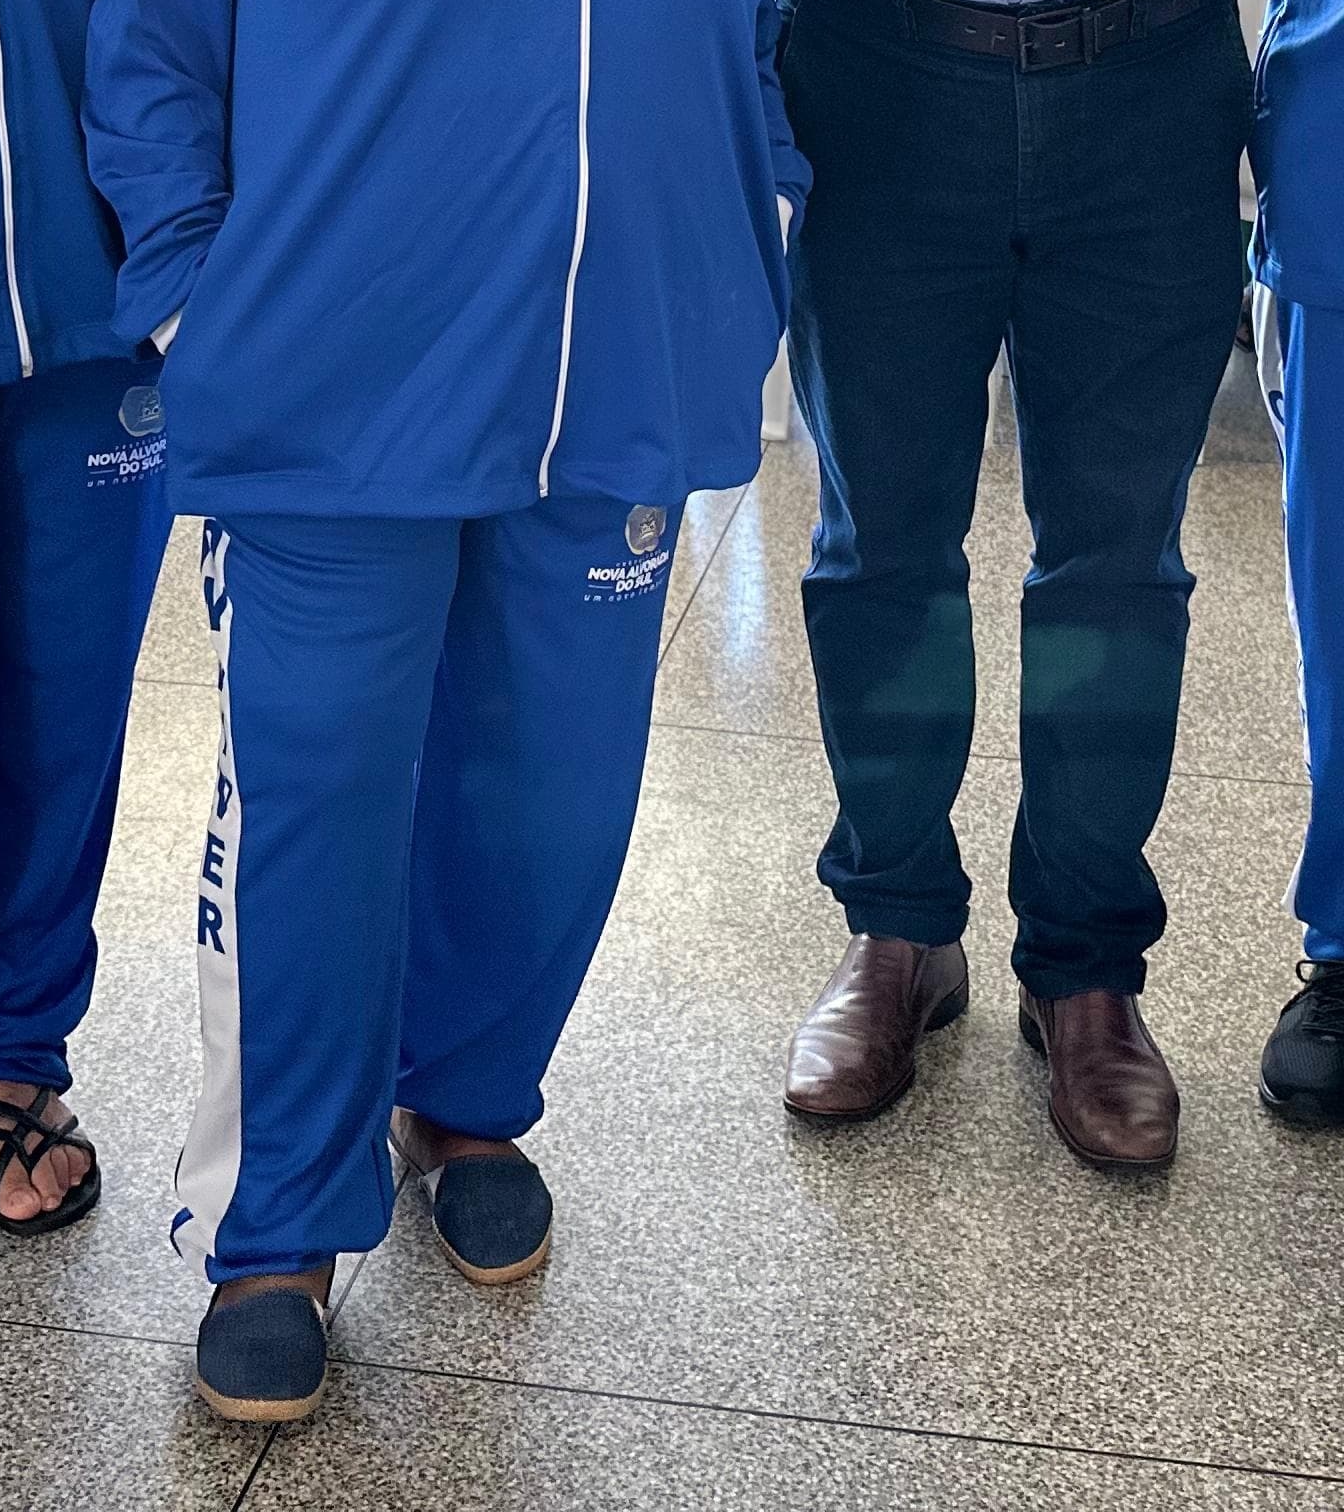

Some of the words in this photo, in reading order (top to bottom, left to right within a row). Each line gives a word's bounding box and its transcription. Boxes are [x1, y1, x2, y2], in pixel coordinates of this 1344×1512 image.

[87, 451, 129, 467] NOVA
[128, 439, 167, 462] ALVOR
[119, 461, 140, 475] DO
[141, 453, 163, 470] SUL
[87, 480, 106, 488] um
[587, 567, 626, 581] NOVA
[615, 579, 634, 593] DO
[634, 571, 653, 589] SUL
